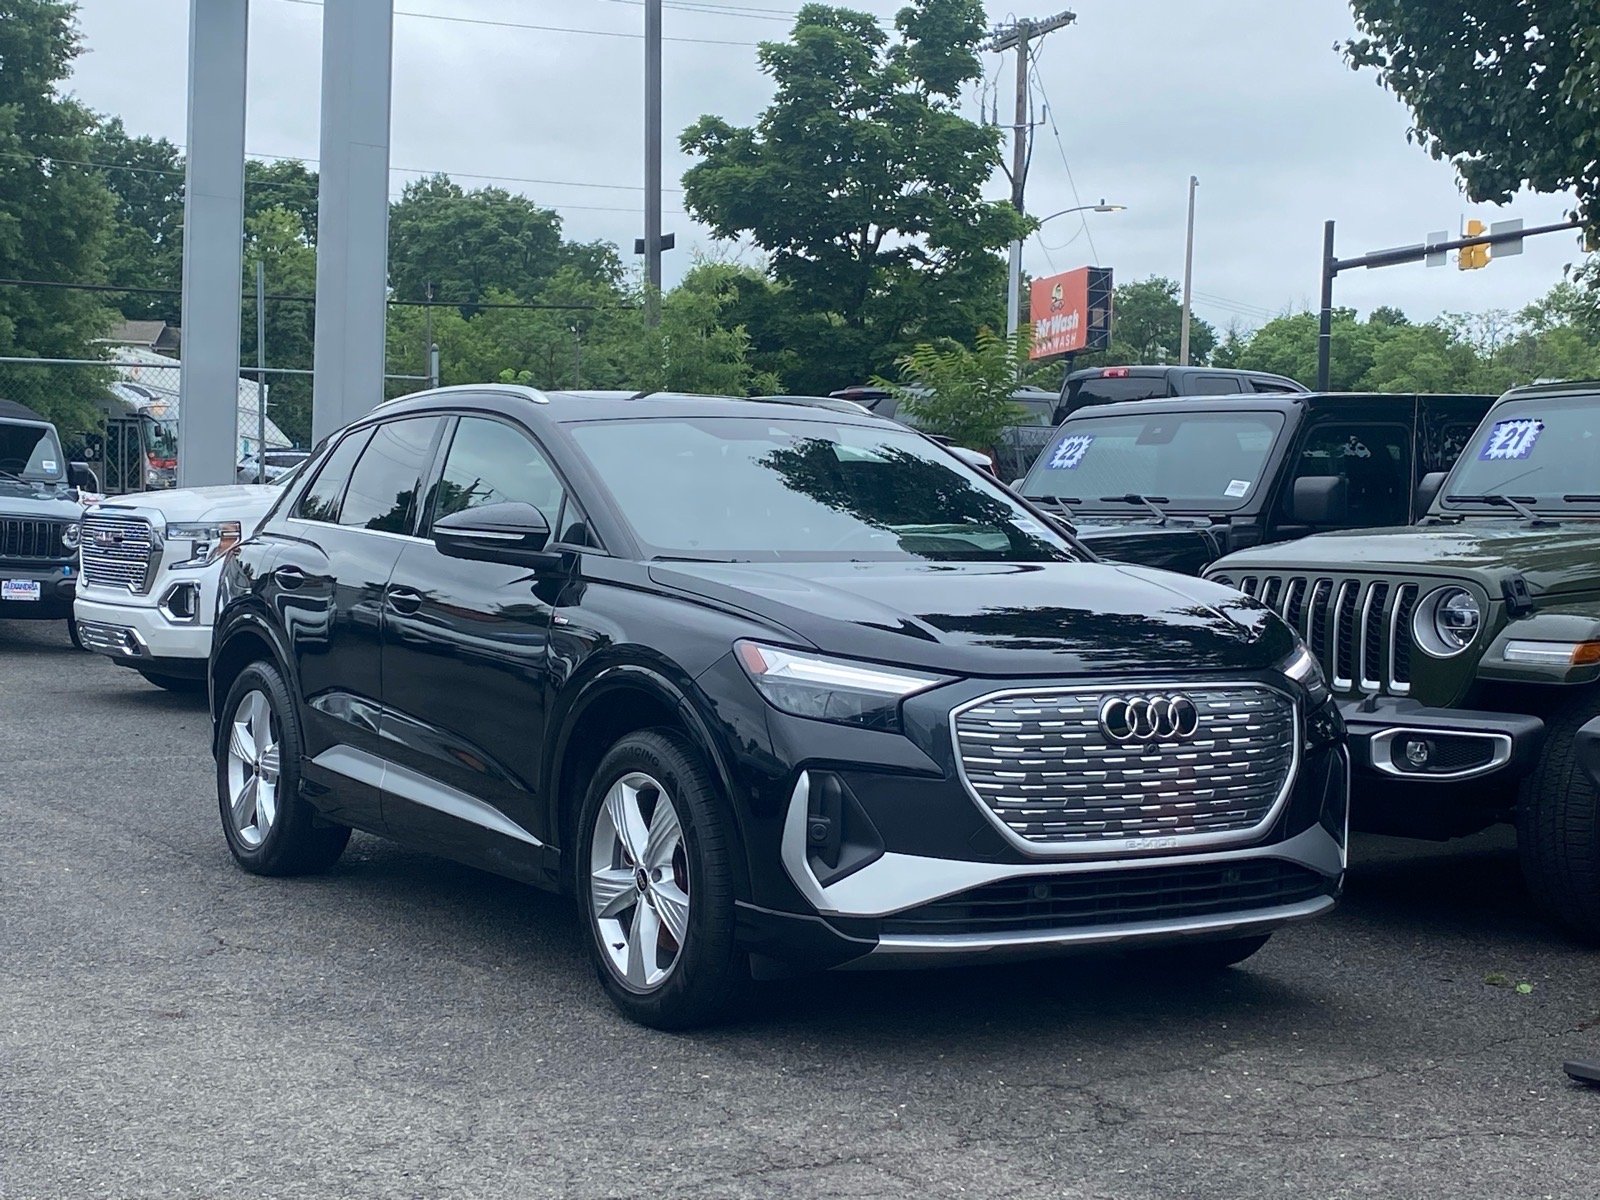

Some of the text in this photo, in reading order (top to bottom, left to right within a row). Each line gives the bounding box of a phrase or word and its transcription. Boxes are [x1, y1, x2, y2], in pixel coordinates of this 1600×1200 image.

[1051, 309, 1079, 335] Wash
[1496, 426, 1530, 450] 21
[1057, 441, 1084, 461] 22
